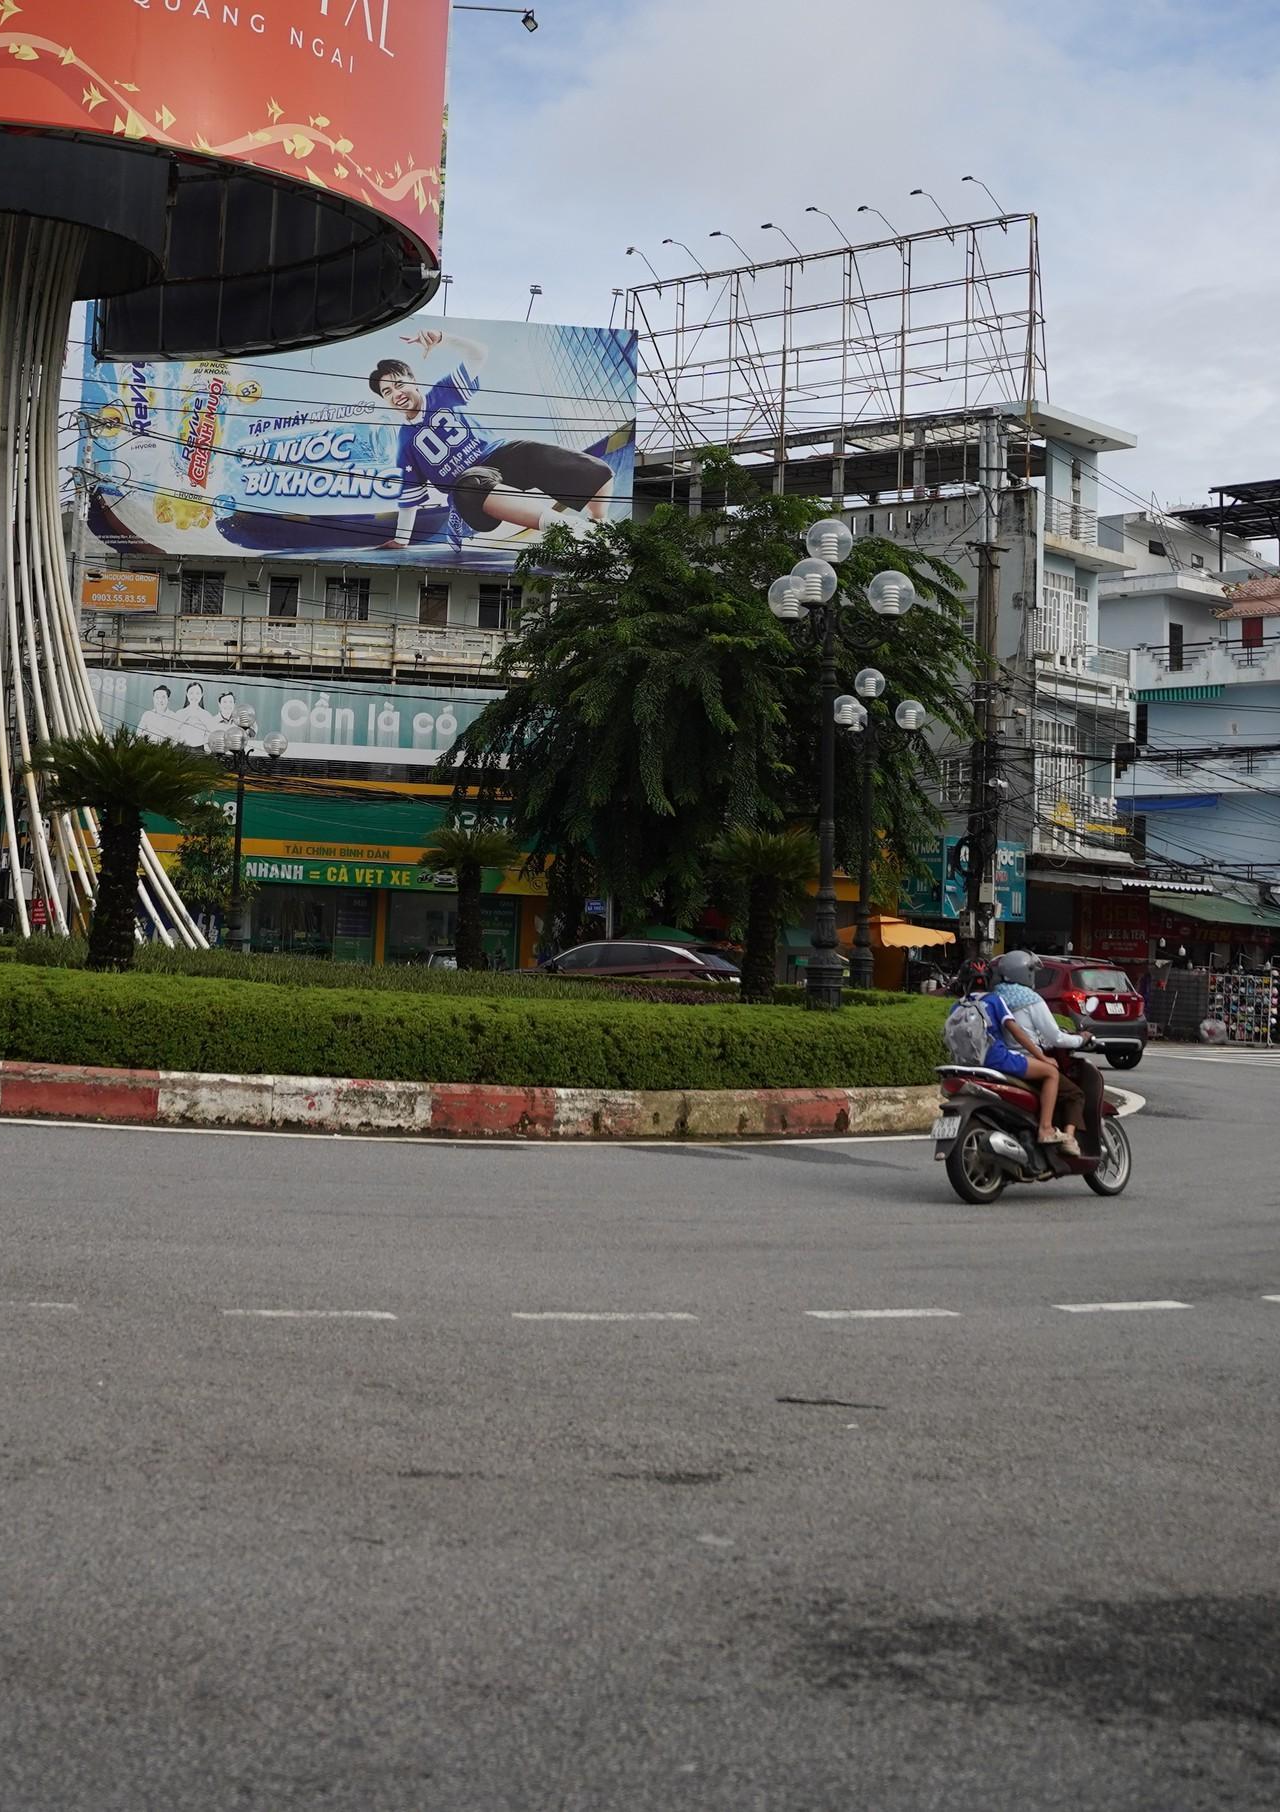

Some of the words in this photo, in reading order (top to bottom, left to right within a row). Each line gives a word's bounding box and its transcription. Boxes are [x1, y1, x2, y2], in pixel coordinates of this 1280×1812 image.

[289, 27, 354, 73] NGAI
[241, 383, 258, 398] B3
[249, 420, 271, 437] TẬP
[273, 410, 308, 430] NHẢY
[413, 408, 469, 465] 03
[193, 421, 215, 480] CHANH
[271, 430, 355, 465] NƯỚC
[243, 465, 273, 496] BÙ
[275, 463, 404, 499] KHOÁNG
[281, 691, 355, 731] Cần
[369, 700, 401, 732] là
[413, 704, 458, 736] có
[245, 862, 304, 880] NHANH
[326, 865, 349, 883] CÀ
[355, 868, 384, 888] VẸT
[390, 871, 411, 886] XE
